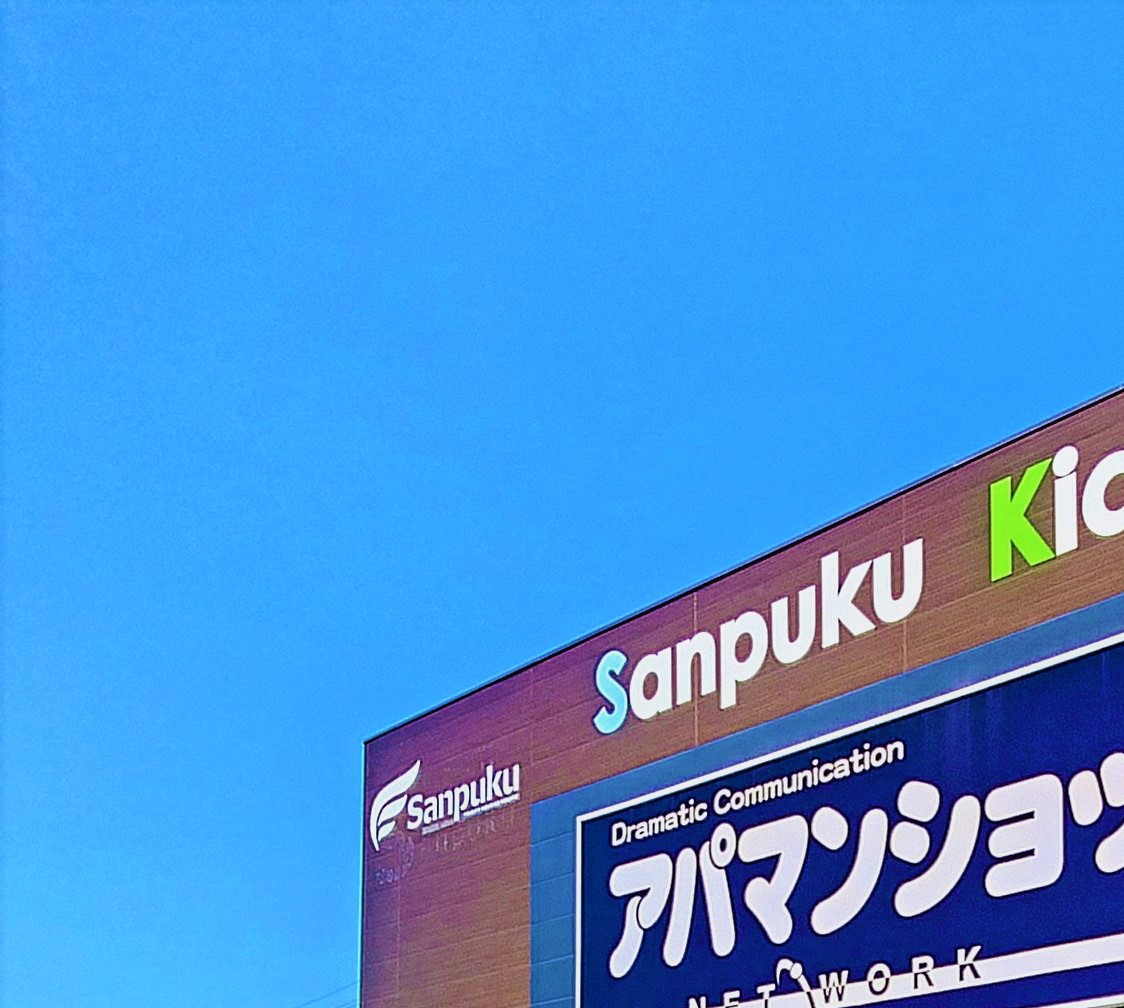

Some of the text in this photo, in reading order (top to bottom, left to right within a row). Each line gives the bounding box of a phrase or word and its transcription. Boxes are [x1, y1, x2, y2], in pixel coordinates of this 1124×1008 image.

[593, 537, 925, 735] Sanpuku
[407, 764, 521, 830] Sanpuku
[611, 740, 905, 846] Dramatic Communication
